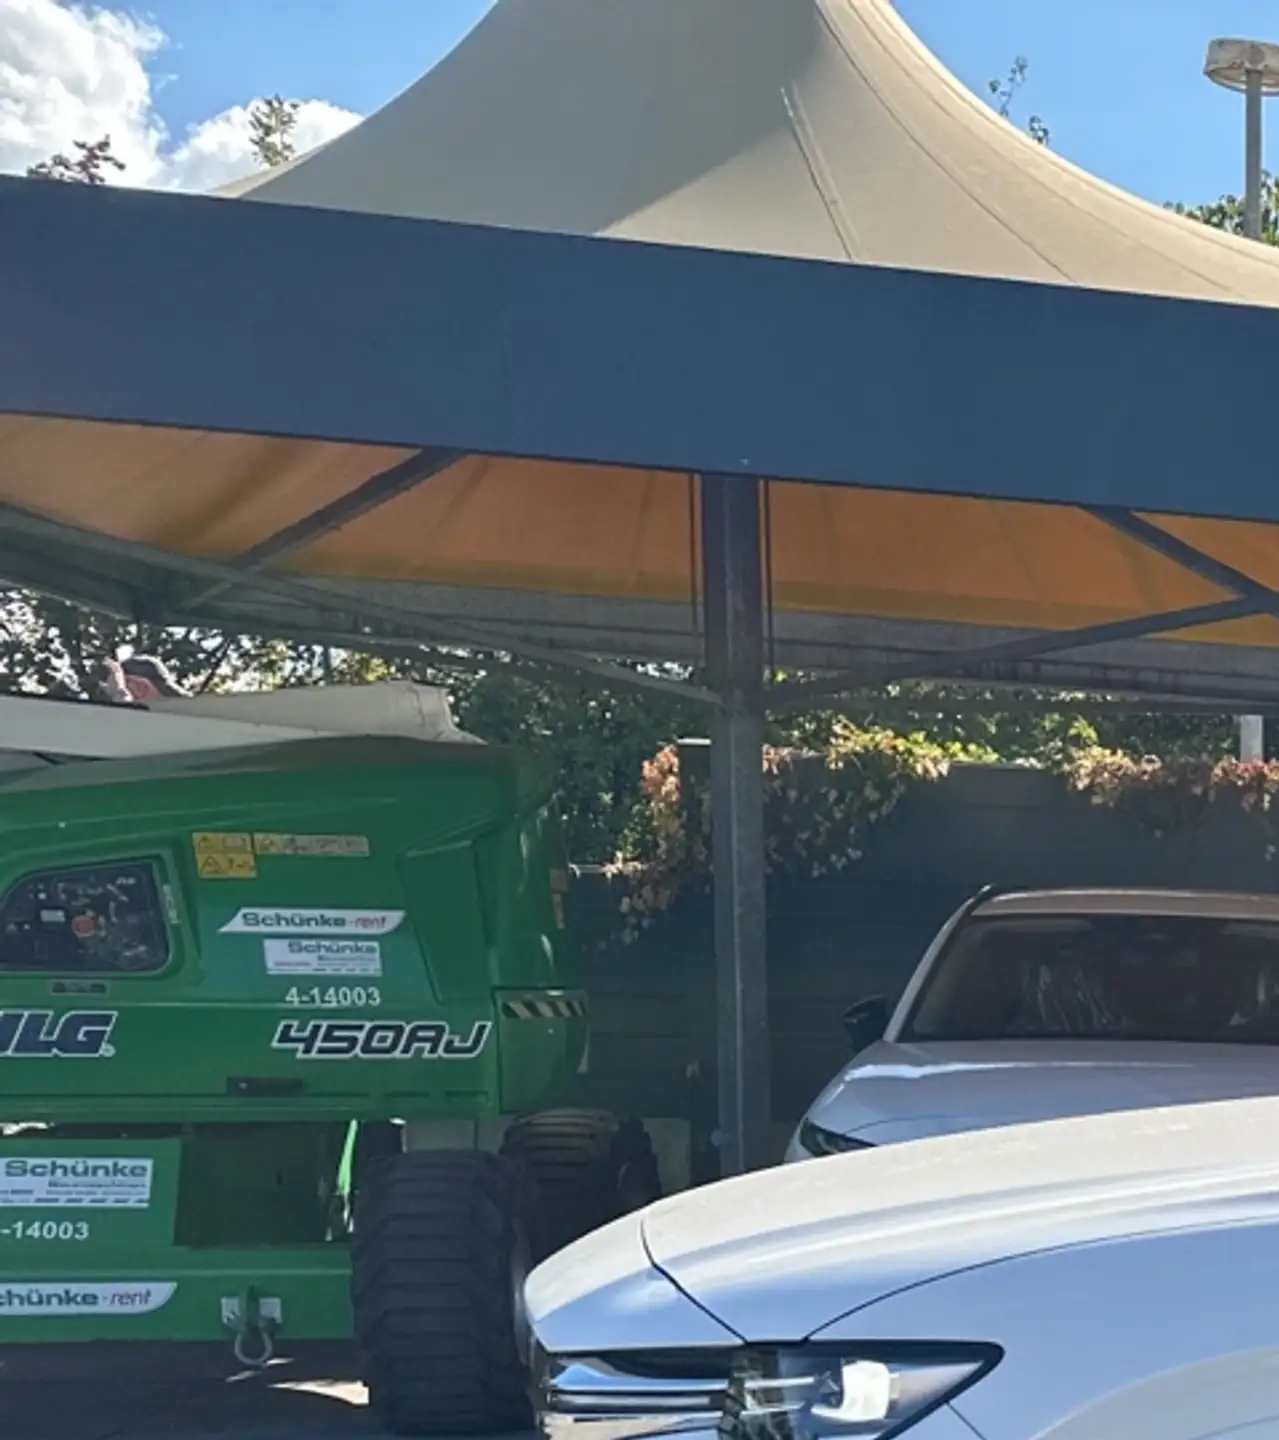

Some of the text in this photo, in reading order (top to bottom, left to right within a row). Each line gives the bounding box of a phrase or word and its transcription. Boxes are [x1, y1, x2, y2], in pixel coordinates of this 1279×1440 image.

[285, 986, 381, 1006] 4-14003
[271, 1020, 492, 1059] 450AJ
[5, 1160, 148, 1177] Schünke
